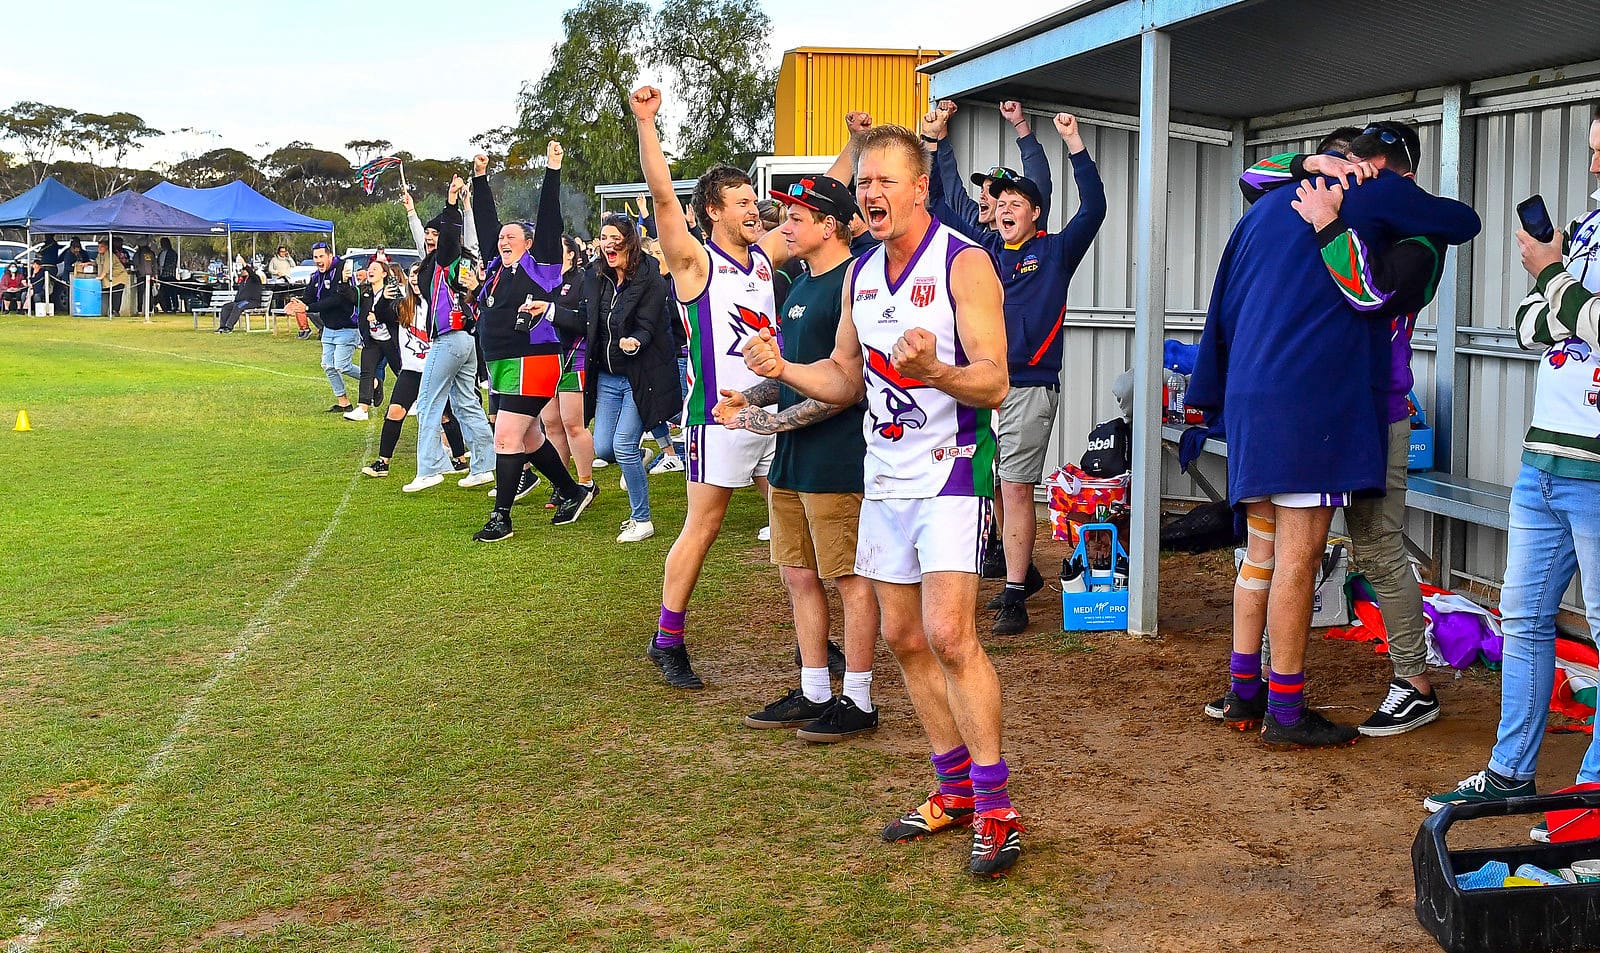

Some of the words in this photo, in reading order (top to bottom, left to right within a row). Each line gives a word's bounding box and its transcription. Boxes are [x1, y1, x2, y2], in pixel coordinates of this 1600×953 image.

[1088, 434, 1115, 451] ebel
[1410, 443, 1426, 451] PRO
[1073, 606, 1093, 614] MEDI
[1109, 605, 1126, 613] PRO
